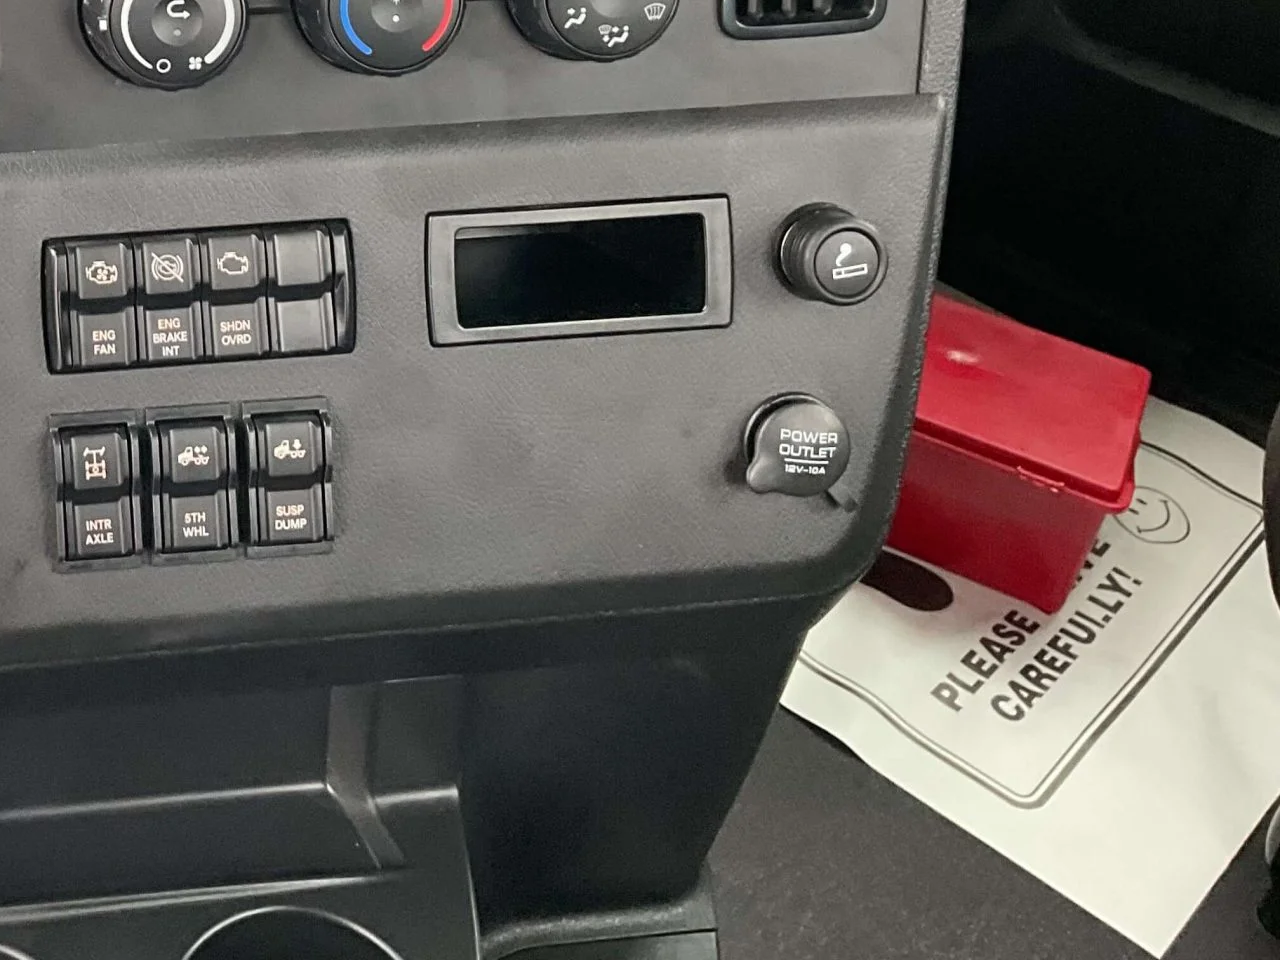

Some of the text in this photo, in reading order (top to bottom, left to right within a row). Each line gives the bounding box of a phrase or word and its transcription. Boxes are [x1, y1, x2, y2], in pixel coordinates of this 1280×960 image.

[158, 318, 181, 330] ENG
[220, 320, 251, 333] SHDN
[92, 329, 116, 342] ENG
[152, 330, 188, 344] BRAKE
[221, 333, 252, 346] OVRD
[93, 342, 117, 356] FAN
[162, 344, 181, 357] INT
[780, 428, 838, 444] POWER
[778, 443, 837, 458] OUTLET
[275, 504, 305, 517] SUSP
[184, 511, 206, 524] 5TH
[274, 517, 308, 531] DUMP
[85, 518, 112, 531] INTR
[183, 525, 209, 538] WHL
[85, 532, 114, 546] AXLE
[990, 566, 1143, 723] CAREFULLY!
[930, 609, 1040, 713] PLEASE
